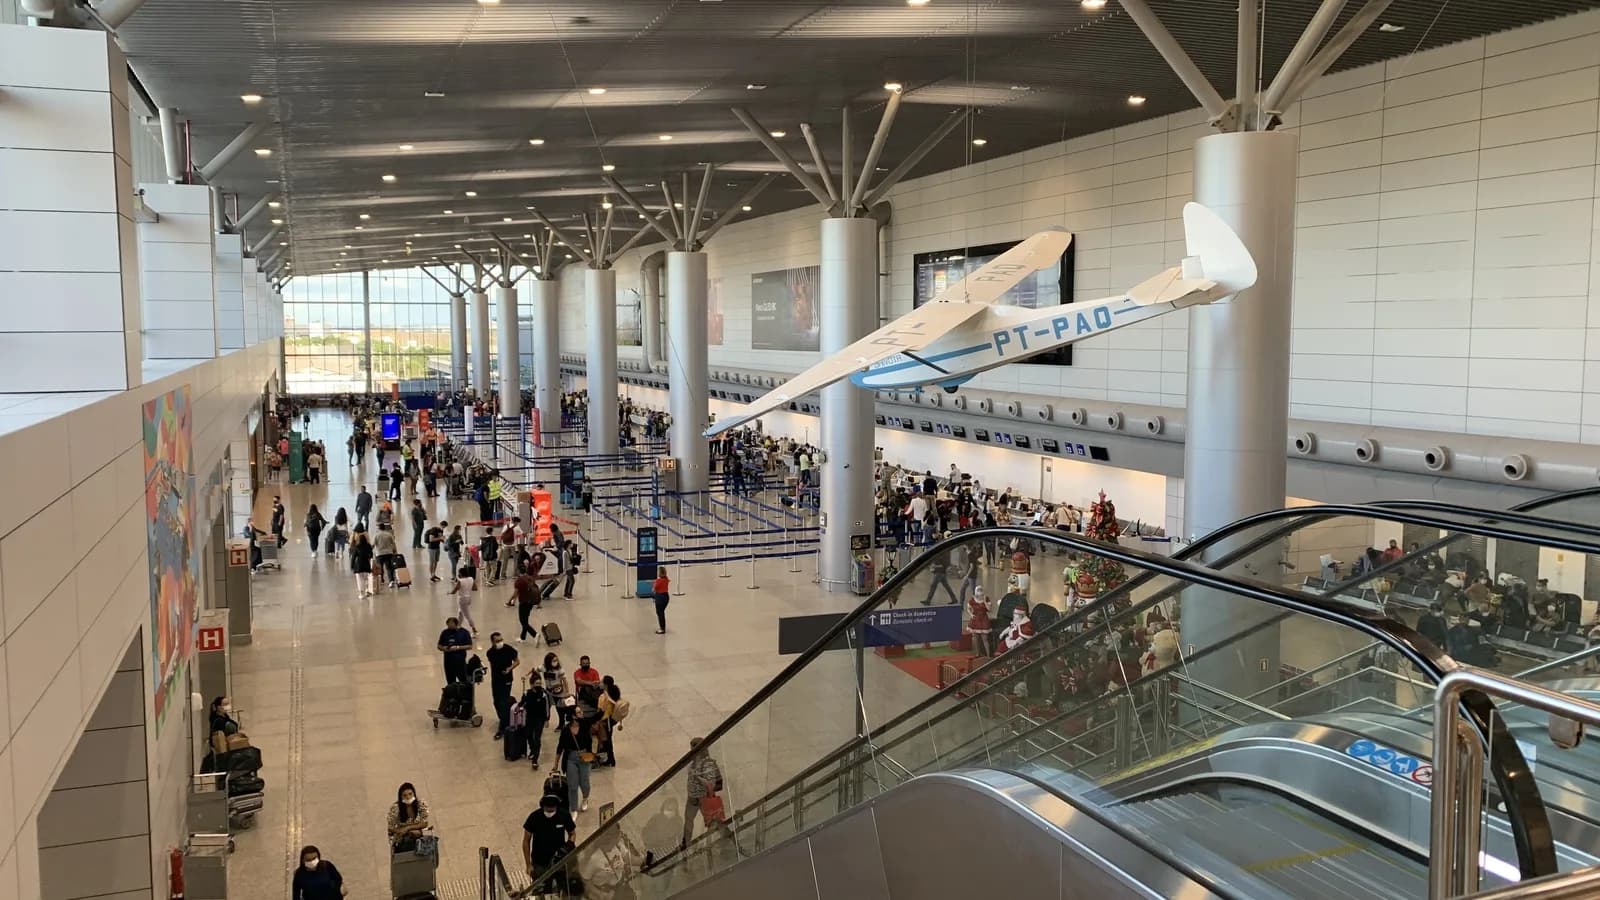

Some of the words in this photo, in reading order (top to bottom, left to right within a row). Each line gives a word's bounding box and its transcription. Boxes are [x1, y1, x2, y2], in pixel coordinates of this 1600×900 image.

[993, 306, 1112, 356] PT-PAQ
[232, 551, 246, 564] H
[203, 631, 219, 648] H
